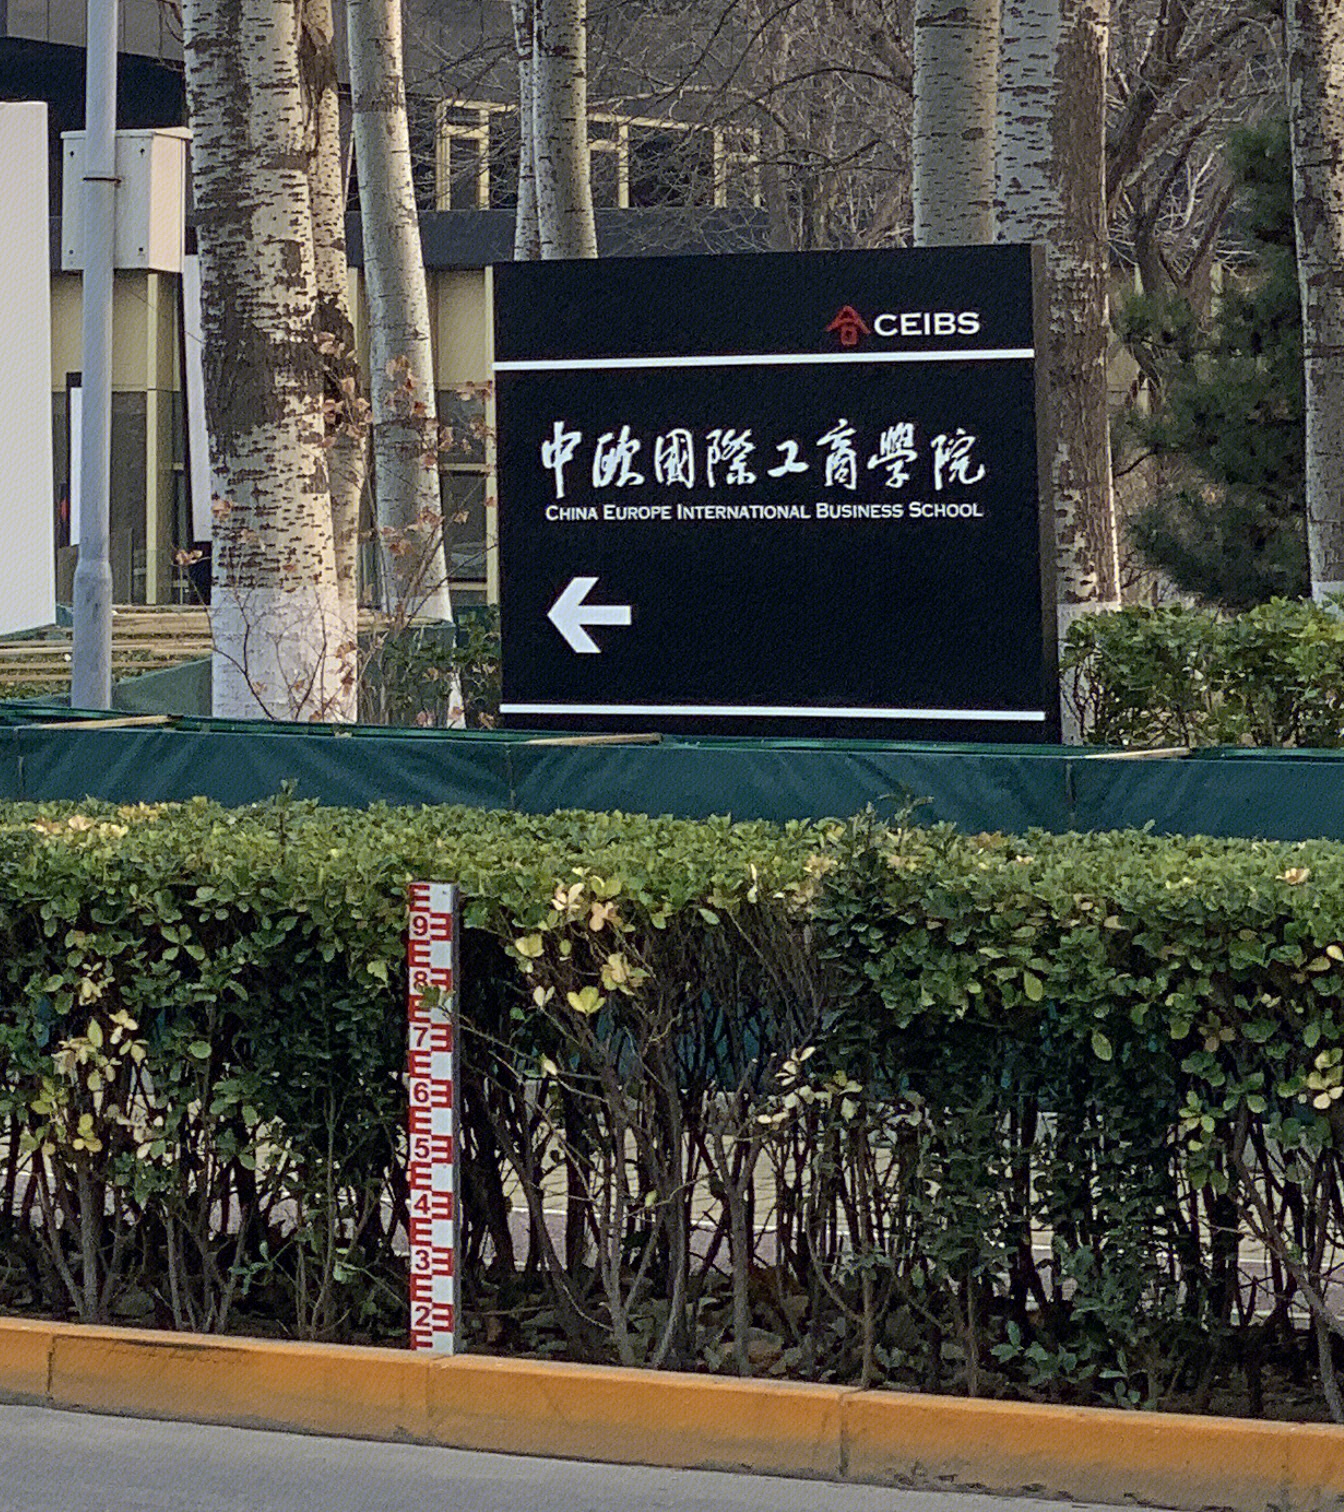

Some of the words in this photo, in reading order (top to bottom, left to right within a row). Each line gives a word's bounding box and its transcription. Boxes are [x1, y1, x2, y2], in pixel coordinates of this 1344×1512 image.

[873, 311, 981, 337] CEIBS
[545, 504, 599, 521] CHINA
[603, 503, 672, 520] EUROPE
[677, 502, 811, 520] INTERNATIONAL
[816, 502, 904, 519] BUSINESS
[909, 500, 984, 518] SCHOOL
[413, 915, 428, 937] 9
[413, 970, 429, 992] 8
[413, 1026, 429, 1047] 7
[414, 1082, 429, 1104] 6
[415, 1138, 430, 1159] 5
[414, 1193, 431, 1215] 4
[415, 1249, 430, 1271] 3
[415, 1305, 431, 1327] 2
